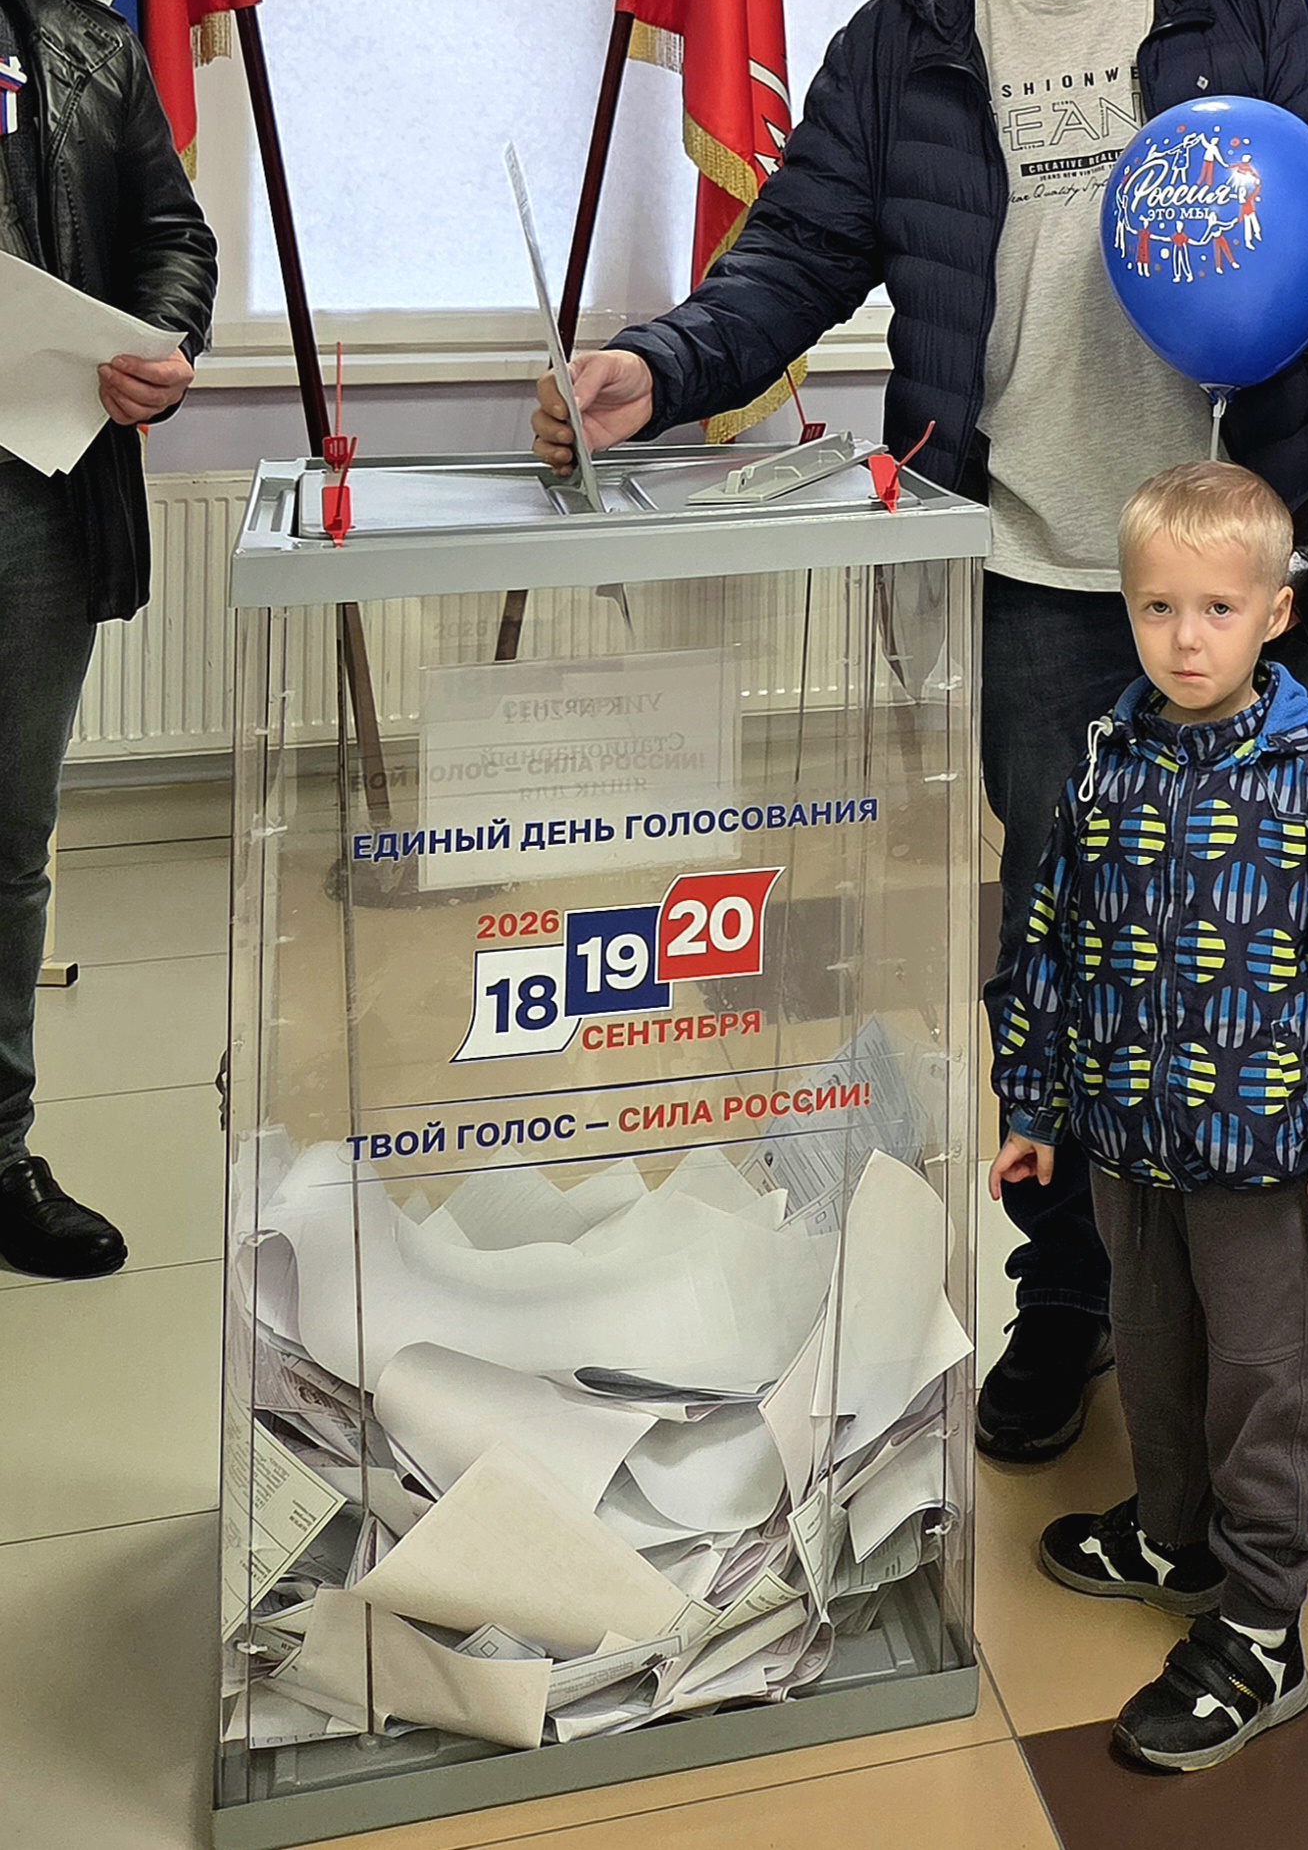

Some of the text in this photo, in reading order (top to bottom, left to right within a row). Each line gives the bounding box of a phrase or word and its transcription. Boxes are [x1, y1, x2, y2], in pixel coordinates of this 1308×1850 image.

[1029, 159, 1083, 174] CREATIVE
[352, 797, 878, 863] ЕДИНЫЙ ДЕНЬ ГОЛОСОВАНИЯ
[477, 910, 559, 939] 2026
[666, 896, 754, 956] 20
[577, 934, 648, 992] 19
[485, 975, 557, 1034] 18
[581, 1010, 761, 1051] СЕНТЯБРЯ
[346, 1121, 445, 1162] ТВОЙ
[458, 1112, 576, 1151] ГОЛОС
[618, 1097, 712, 1134] СИЛА
[723, 1082, 871, 1123] РОССИИ!
